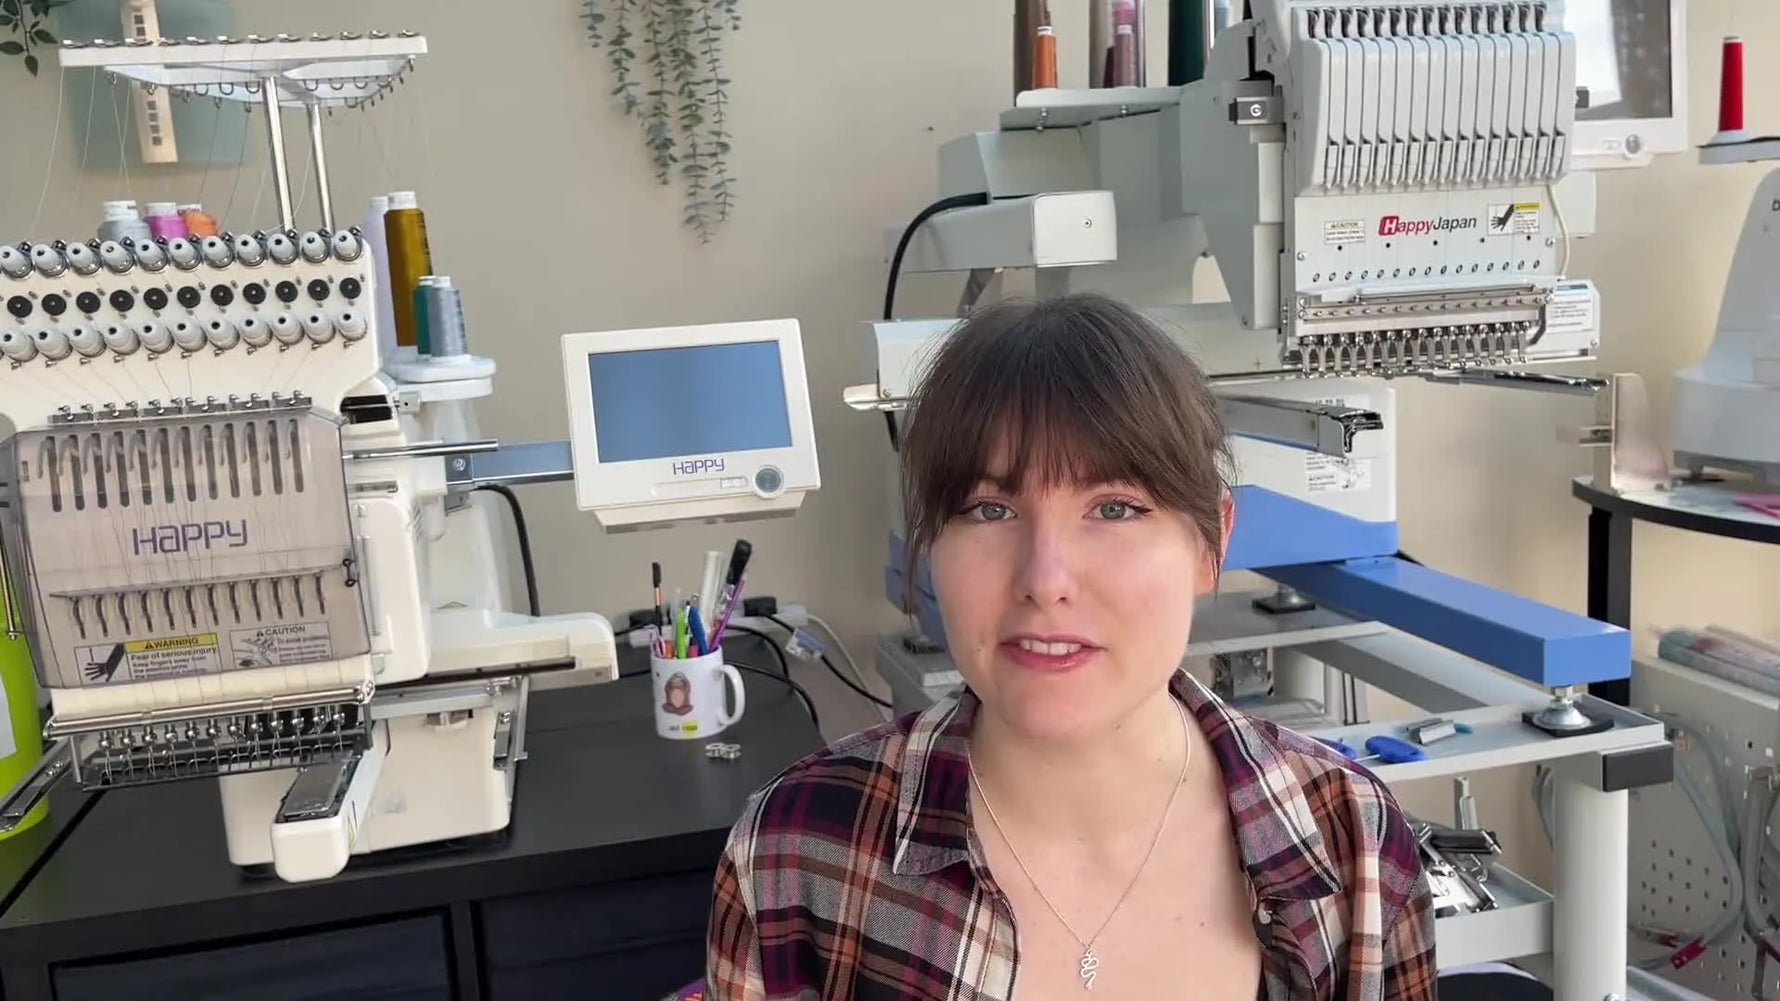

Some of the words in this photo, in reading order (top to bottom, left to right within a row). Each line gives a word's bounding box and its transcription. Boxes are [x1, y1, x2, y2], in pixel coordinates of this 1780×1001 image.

[1379, 216, 1477, 235] HappyJapan
[673, 458, 725, 475] Happy
[132, 519, 248, 555] Happy
[265, 626, 306, 636] CAUTION
[153, 637, 199, 649] WARNING
[131, 653, 150, 661] Fear
[161, 649, 192, 658] serious
[193, 647, 217, 656] injury
